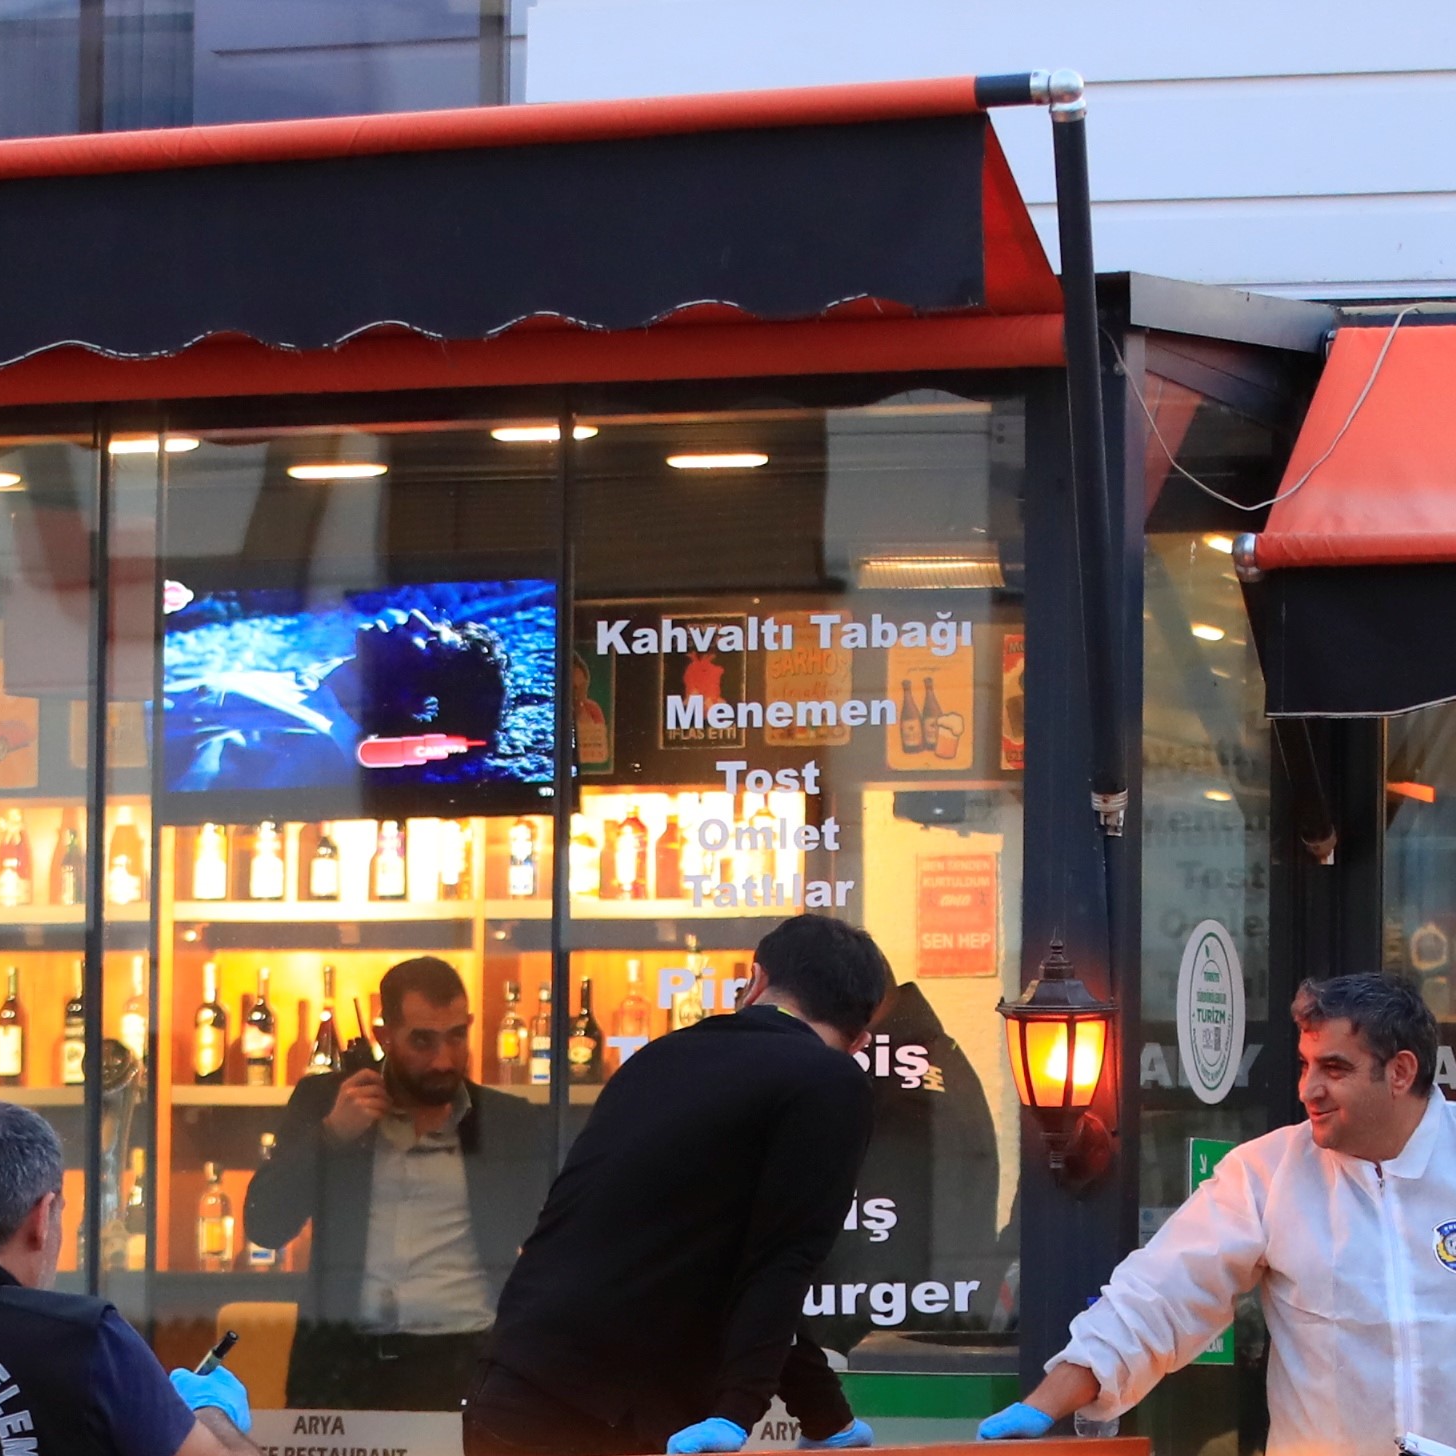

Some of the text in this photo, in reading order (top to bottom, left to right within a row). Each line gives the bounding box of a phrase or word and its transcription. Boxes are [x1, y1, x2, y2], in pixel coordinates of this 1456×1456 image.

[596, 616, 793, 656] Kahvaltı
[809, 611, 974, 657] Tabağı
[666, 694, 897, 730] Menemen
[715, 760, 821, 795] Tost
[698, 816, 840, 851] Omlet
[683, 873, 855, 908] Tatlılar
[922, 932, 992, 949] SEN HEP
[658, 967, 749, 1010] Pir
[293, 1415, 346, 1435] ARYA
[760, 1421, 802, 1441] ARY
